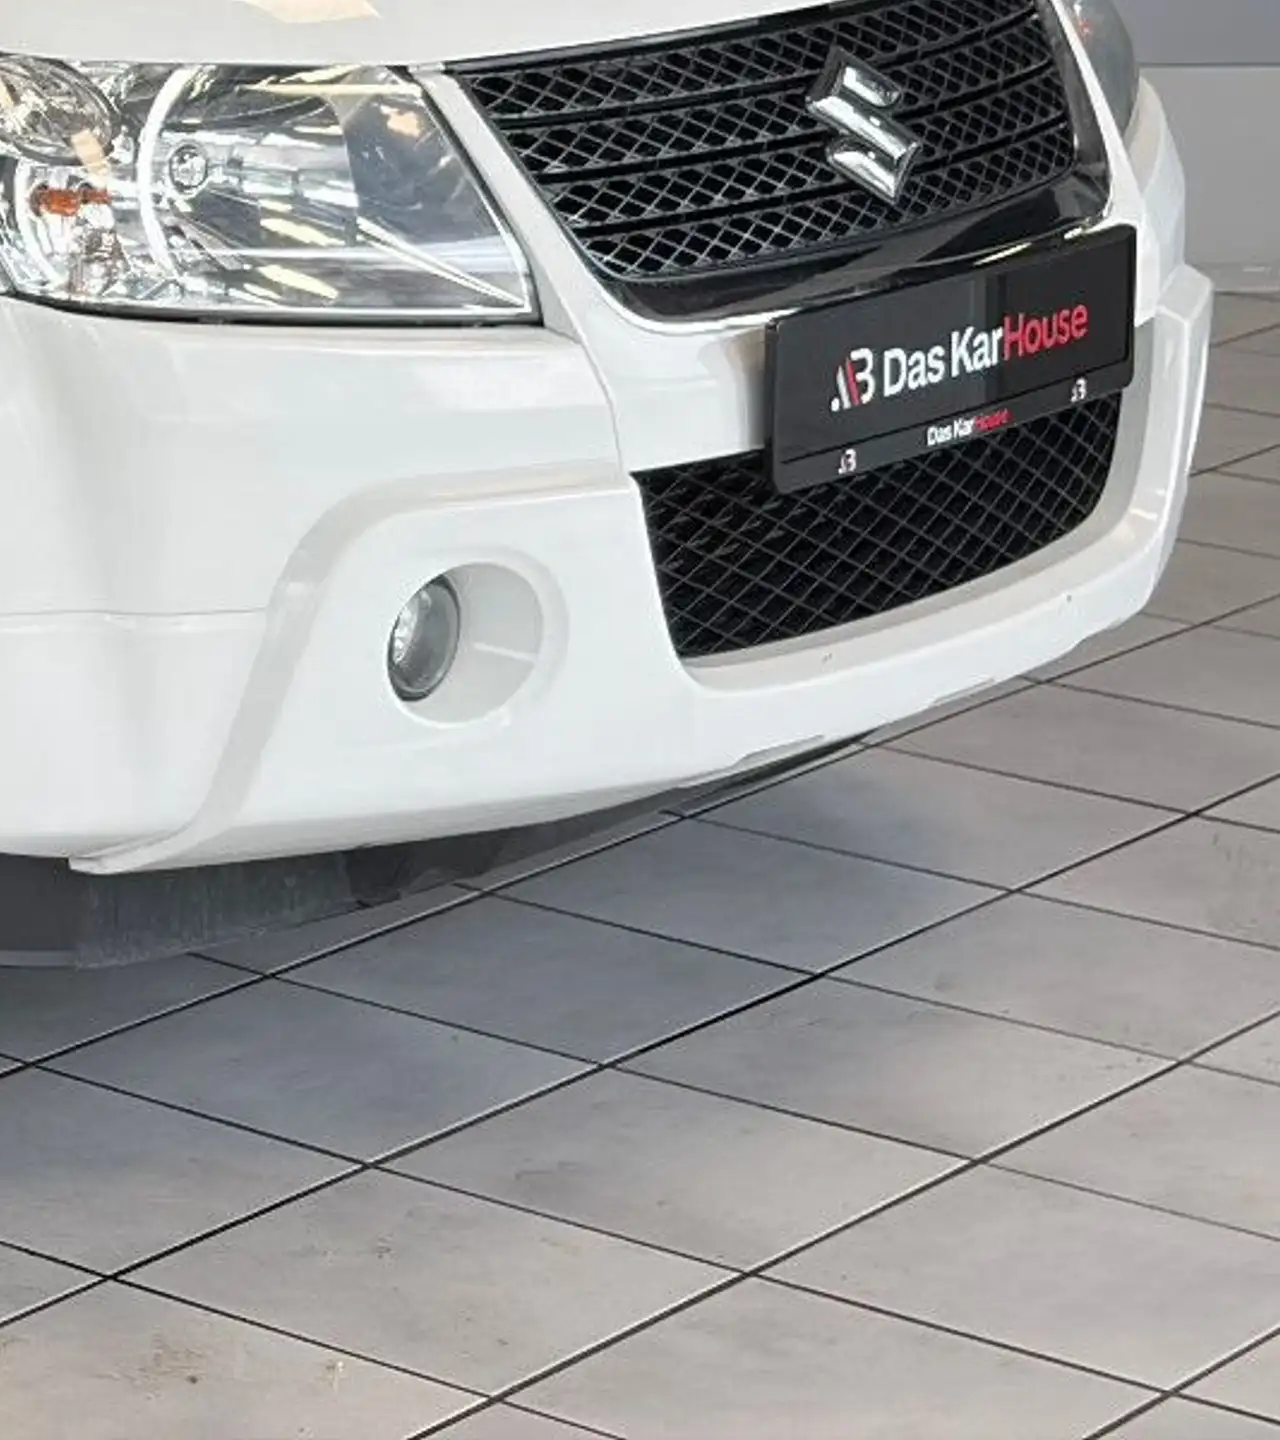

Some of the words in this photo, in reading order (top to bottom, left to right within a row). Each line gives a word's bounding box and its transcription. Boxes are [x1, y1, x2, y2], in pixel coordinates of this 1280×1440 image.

[883, 346, 946, 398] Das
[950, 303, 1089, 379] KarHouse
[926, 424, 953, 447] Das
